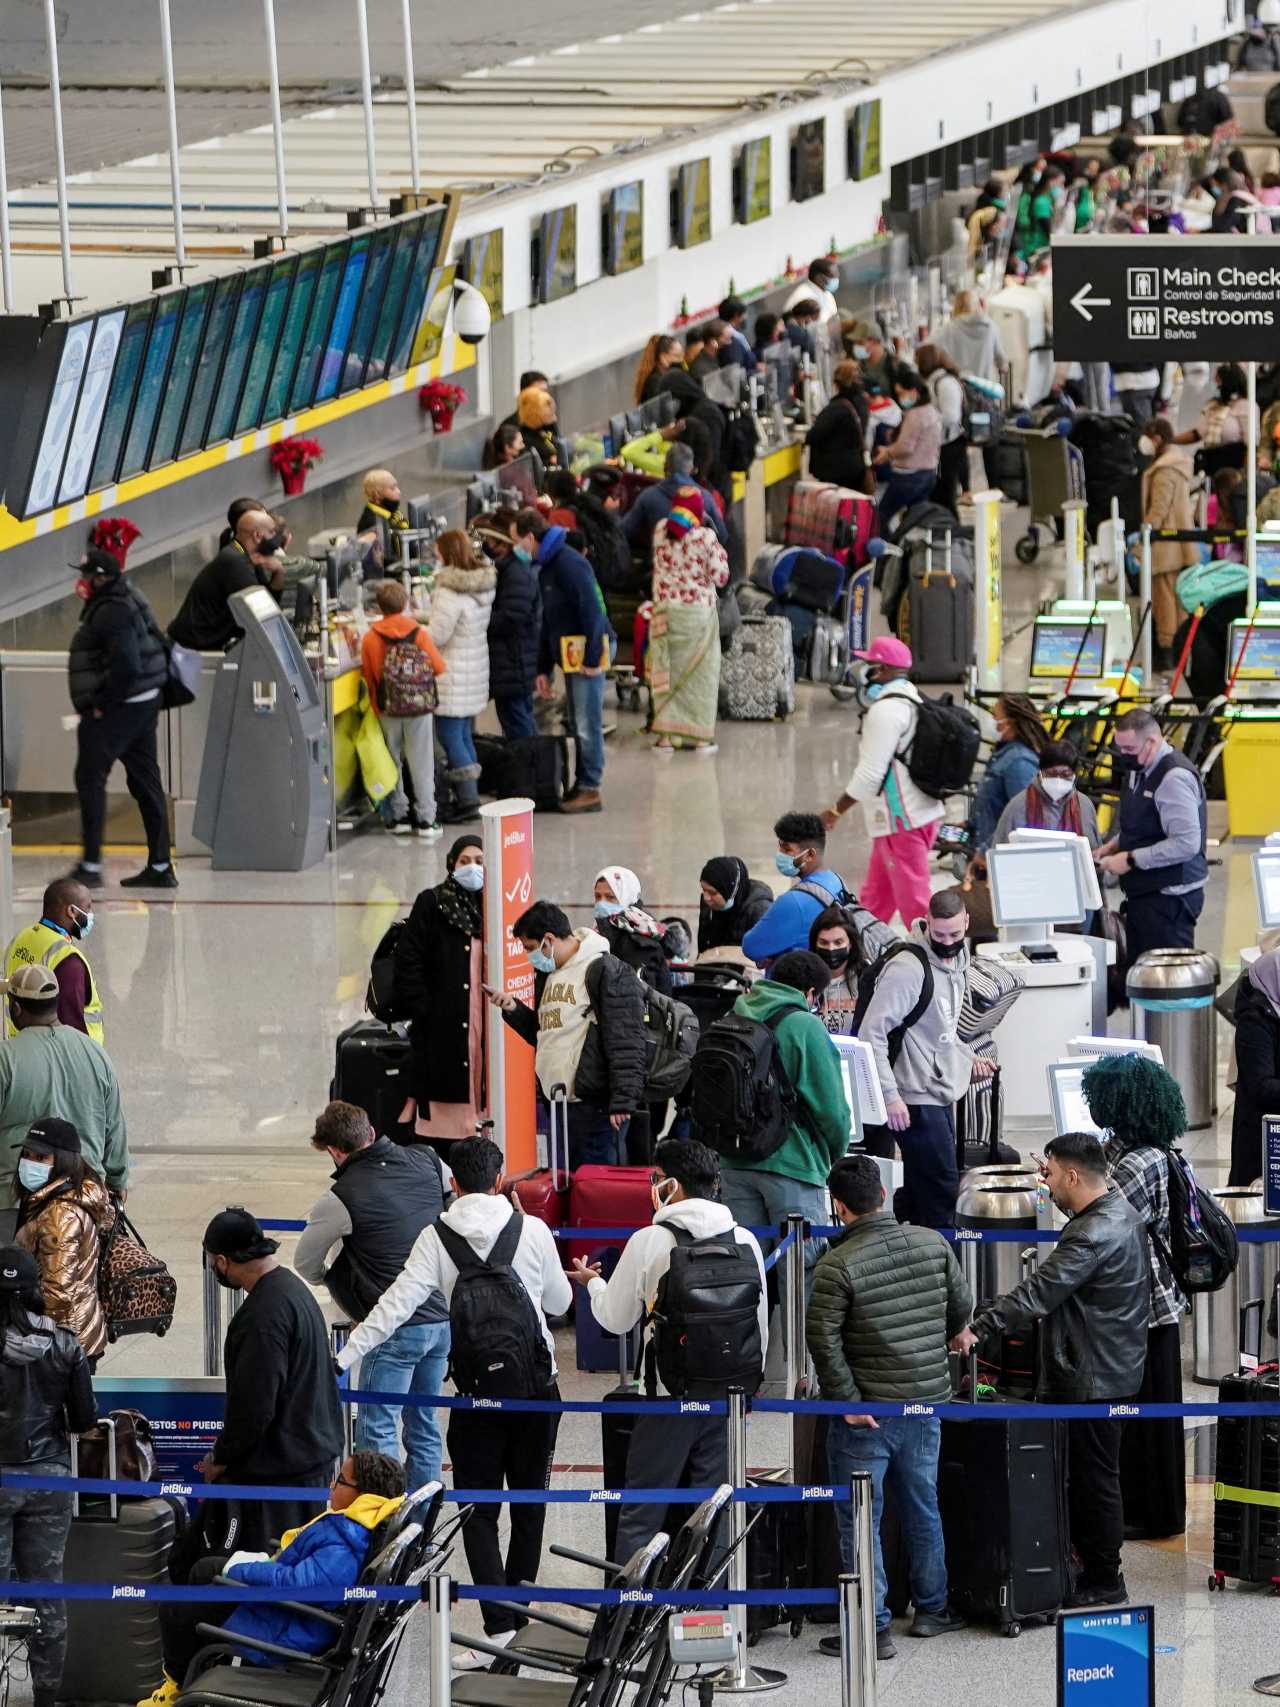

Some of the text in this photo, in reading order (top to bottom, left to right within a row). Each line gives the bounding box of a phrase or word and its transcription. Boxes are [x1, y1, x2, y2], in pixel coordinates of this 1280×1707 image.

[1163, 267, 1211, 286] Main
[1164, 289, 1203, 301] Control
[1204, 289, 1219, 301] de
[1221, 289, 1274, 303] Seguridad
[1163, 306, 1274, 326] Restrooms
[1164, 328, 1197, 340] Baños
[954, 1229, 983, 1241] jetBlue
[472, 1398, 502, 1409] jetBlue
[680, 1401, 710, 1413] jetBlue
[903, 1404, 934, 1416] jetBlue
[1109, 1404, 1140, 1416] jetBlue
[178, 1421, 192, 1430] NO
[192, 1421, 225, 1430] PUEDE
[160, 1483, 193, 1495] jetBlue
[589, 1489, 621, 1501] jetBlue
[801, 1487, 834, 1499] jetBlue
[112, 1585, 146, 1599] jetBlue
[344, 1587, 377, 1600] jetBlue
[620, 1590, 653, 1603] jetBlue
[1082, 1617, 1120, 1628] UNITED
[1067, 1664, 1115, 1684] Repack
